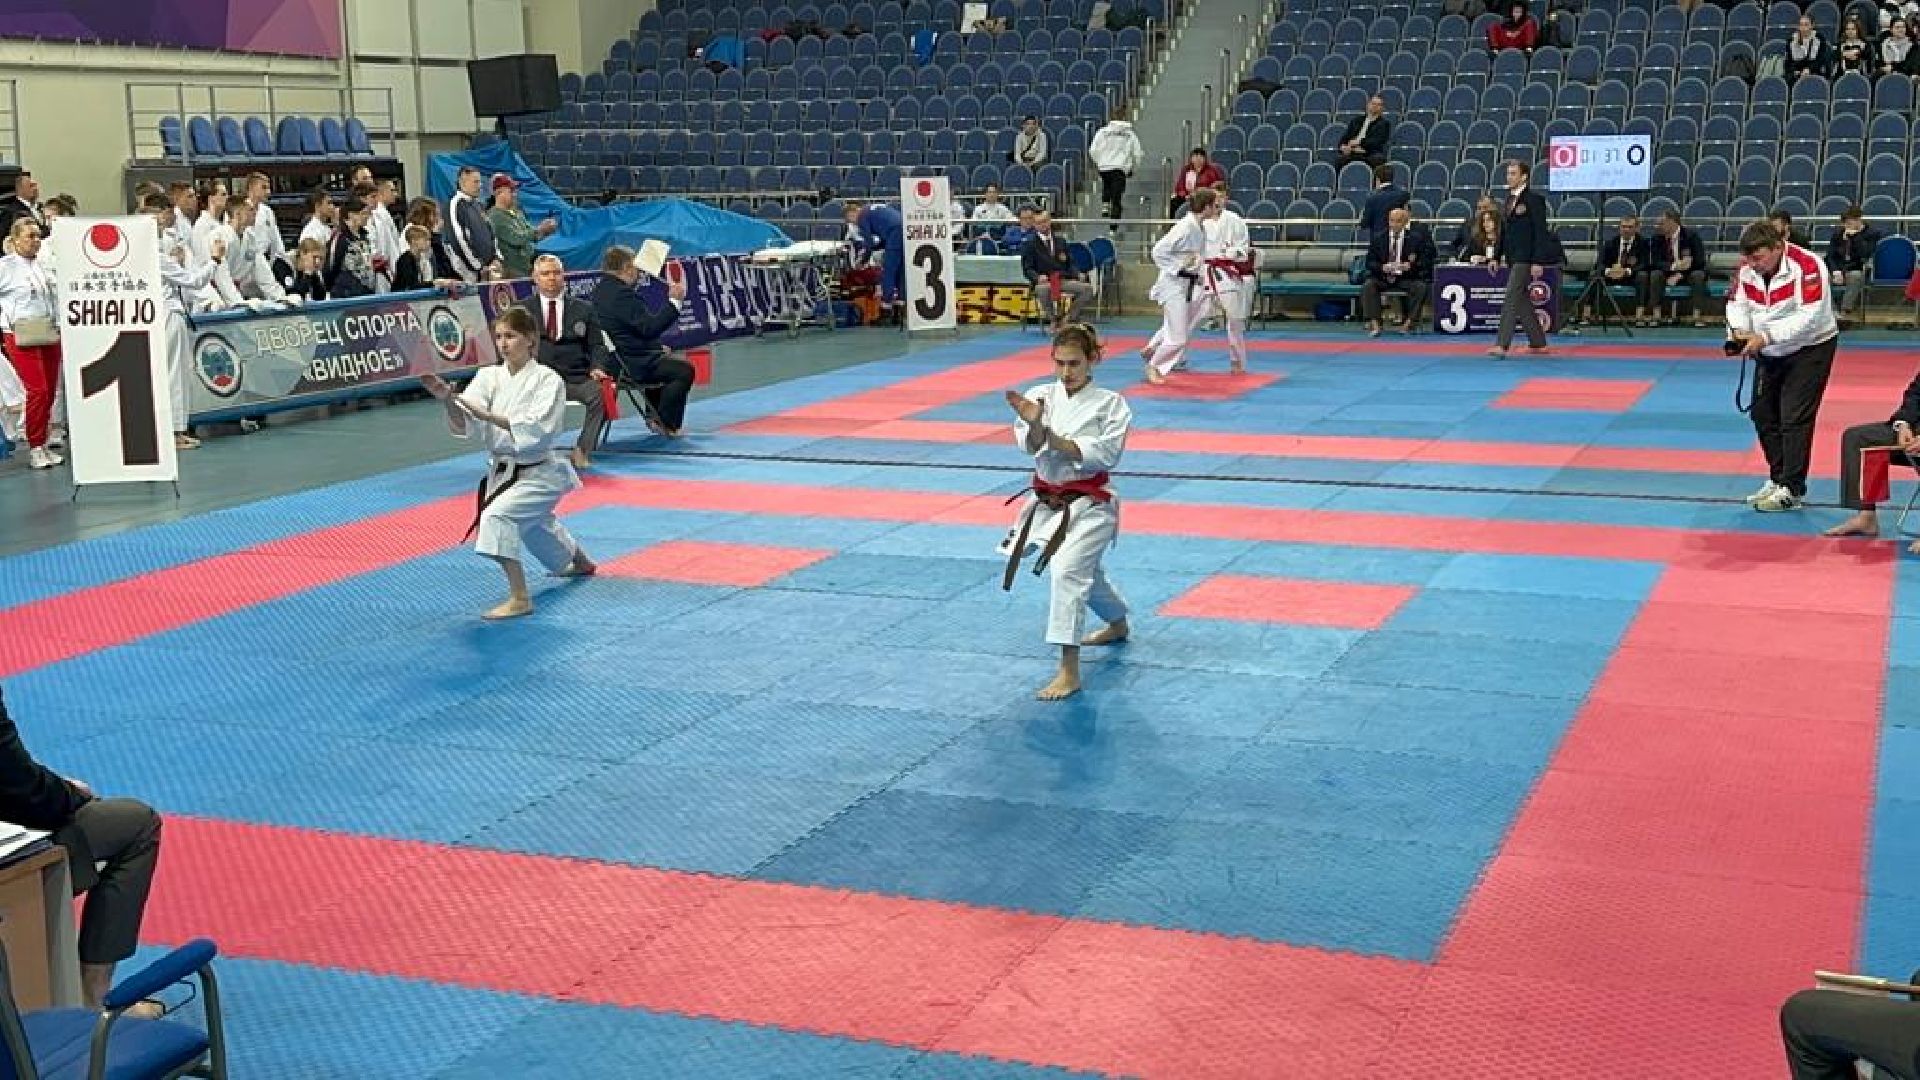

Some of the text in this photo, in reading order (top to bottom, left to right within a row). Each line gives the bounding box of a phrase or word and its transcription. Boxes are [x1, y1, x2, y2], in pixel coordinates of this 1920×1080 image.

[906, 224, 947, 240] SHIAI JO
[912, 244, 947, 321] 3
[68, 298, 156, 326] SHIAI JO
[1440, 284, 1467, 333] 3
[254, 310, 421, 355] ДВОРЕЦ СПОРТА
[302, 349, 404, 382] «ВИДНОЕ»
[80, 330, 160, 466] 1
